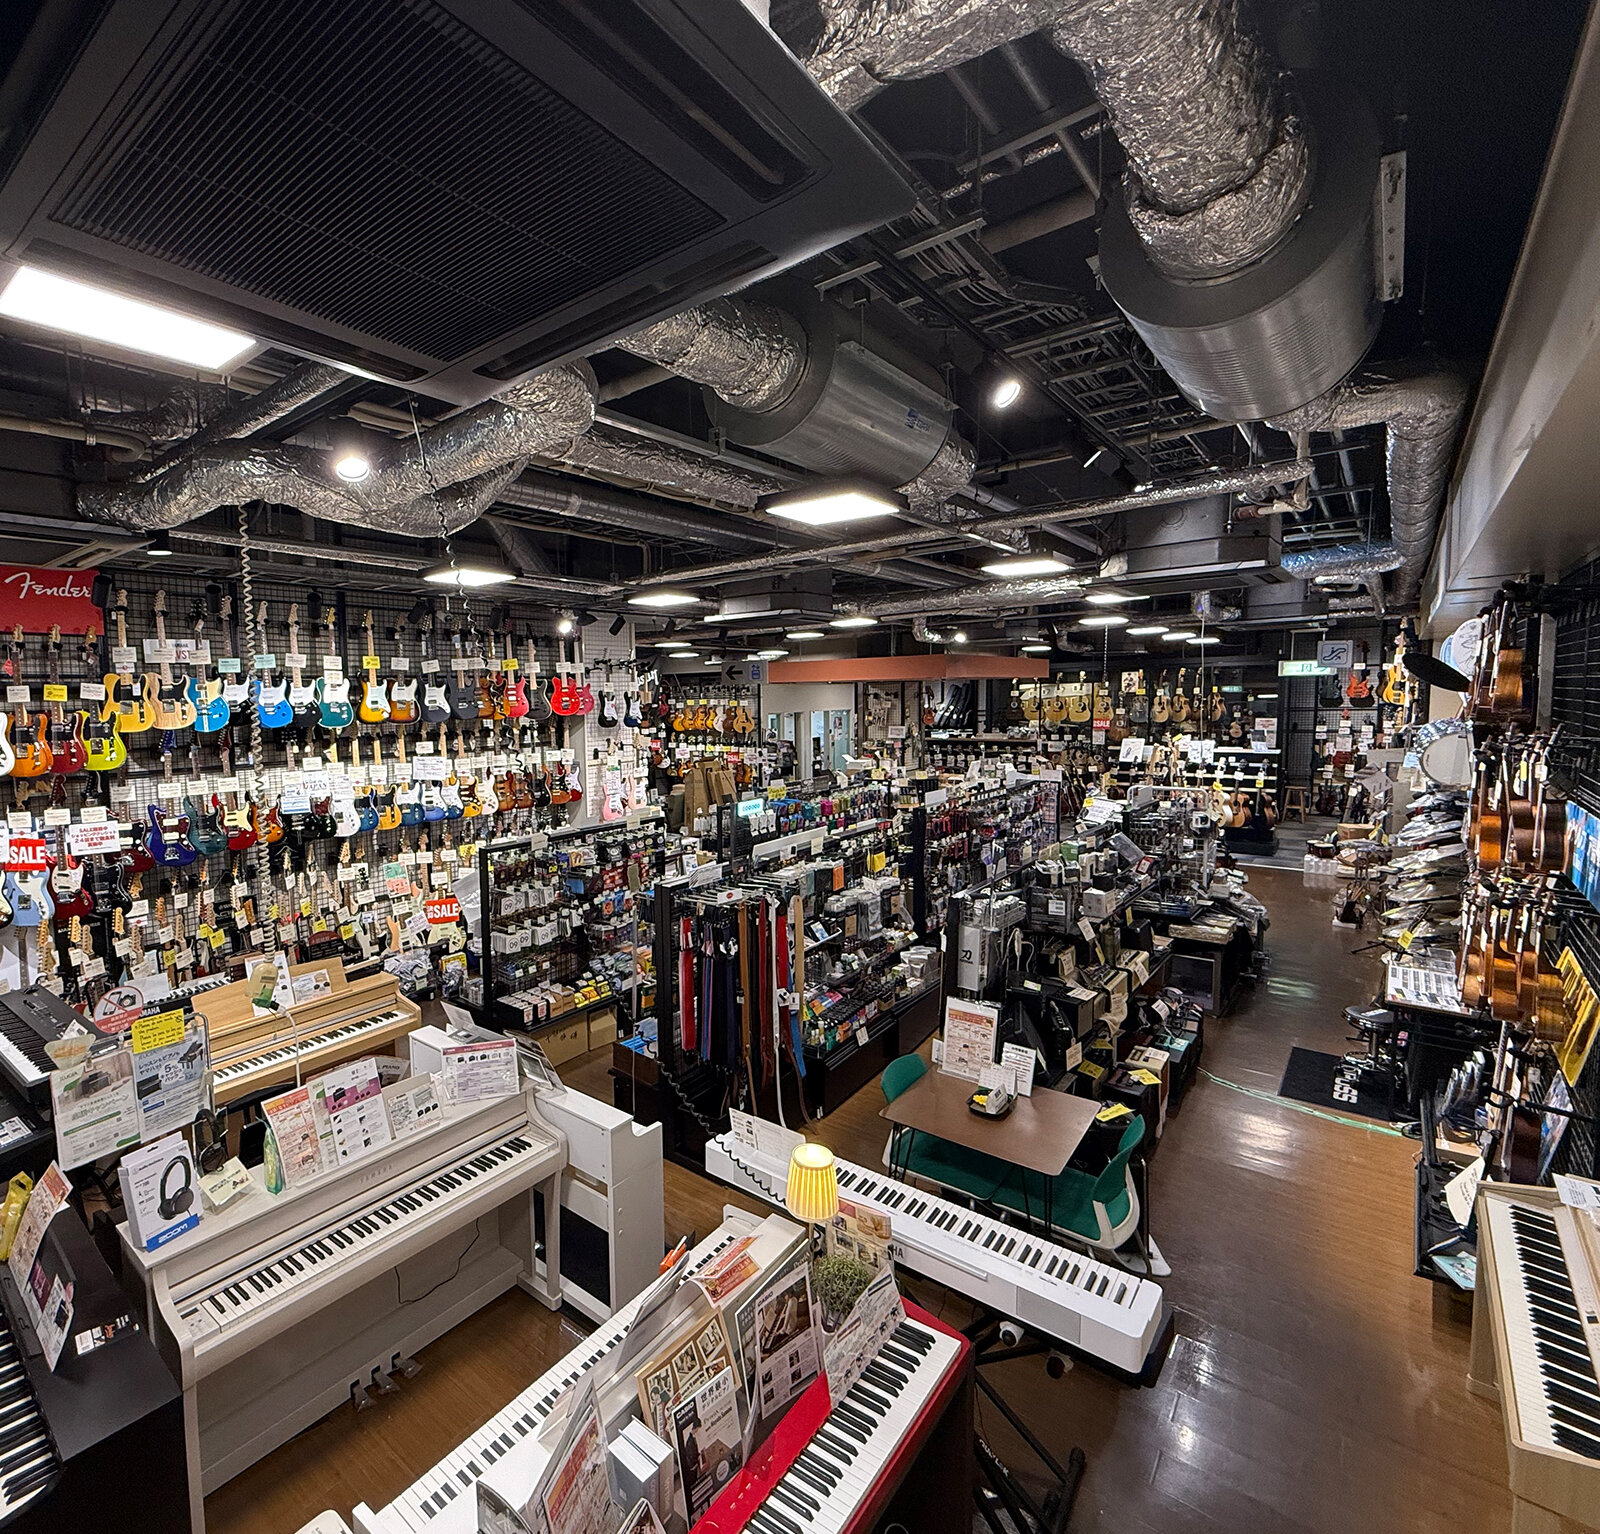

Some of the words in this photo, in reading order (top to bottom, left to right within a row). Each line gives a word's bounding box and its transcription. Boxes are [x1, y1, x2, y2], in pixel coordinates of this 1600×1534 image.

[4, 572, 91, 599] Fender
[10, 845, 46, 864] SALE
[434, 903, 459, 918] SALE
[158, 1223, 188, 1243] ZOOM
[701, 1376, 729, 1402] 世界最小
[676, 1401, 695, 1419] CASIO
